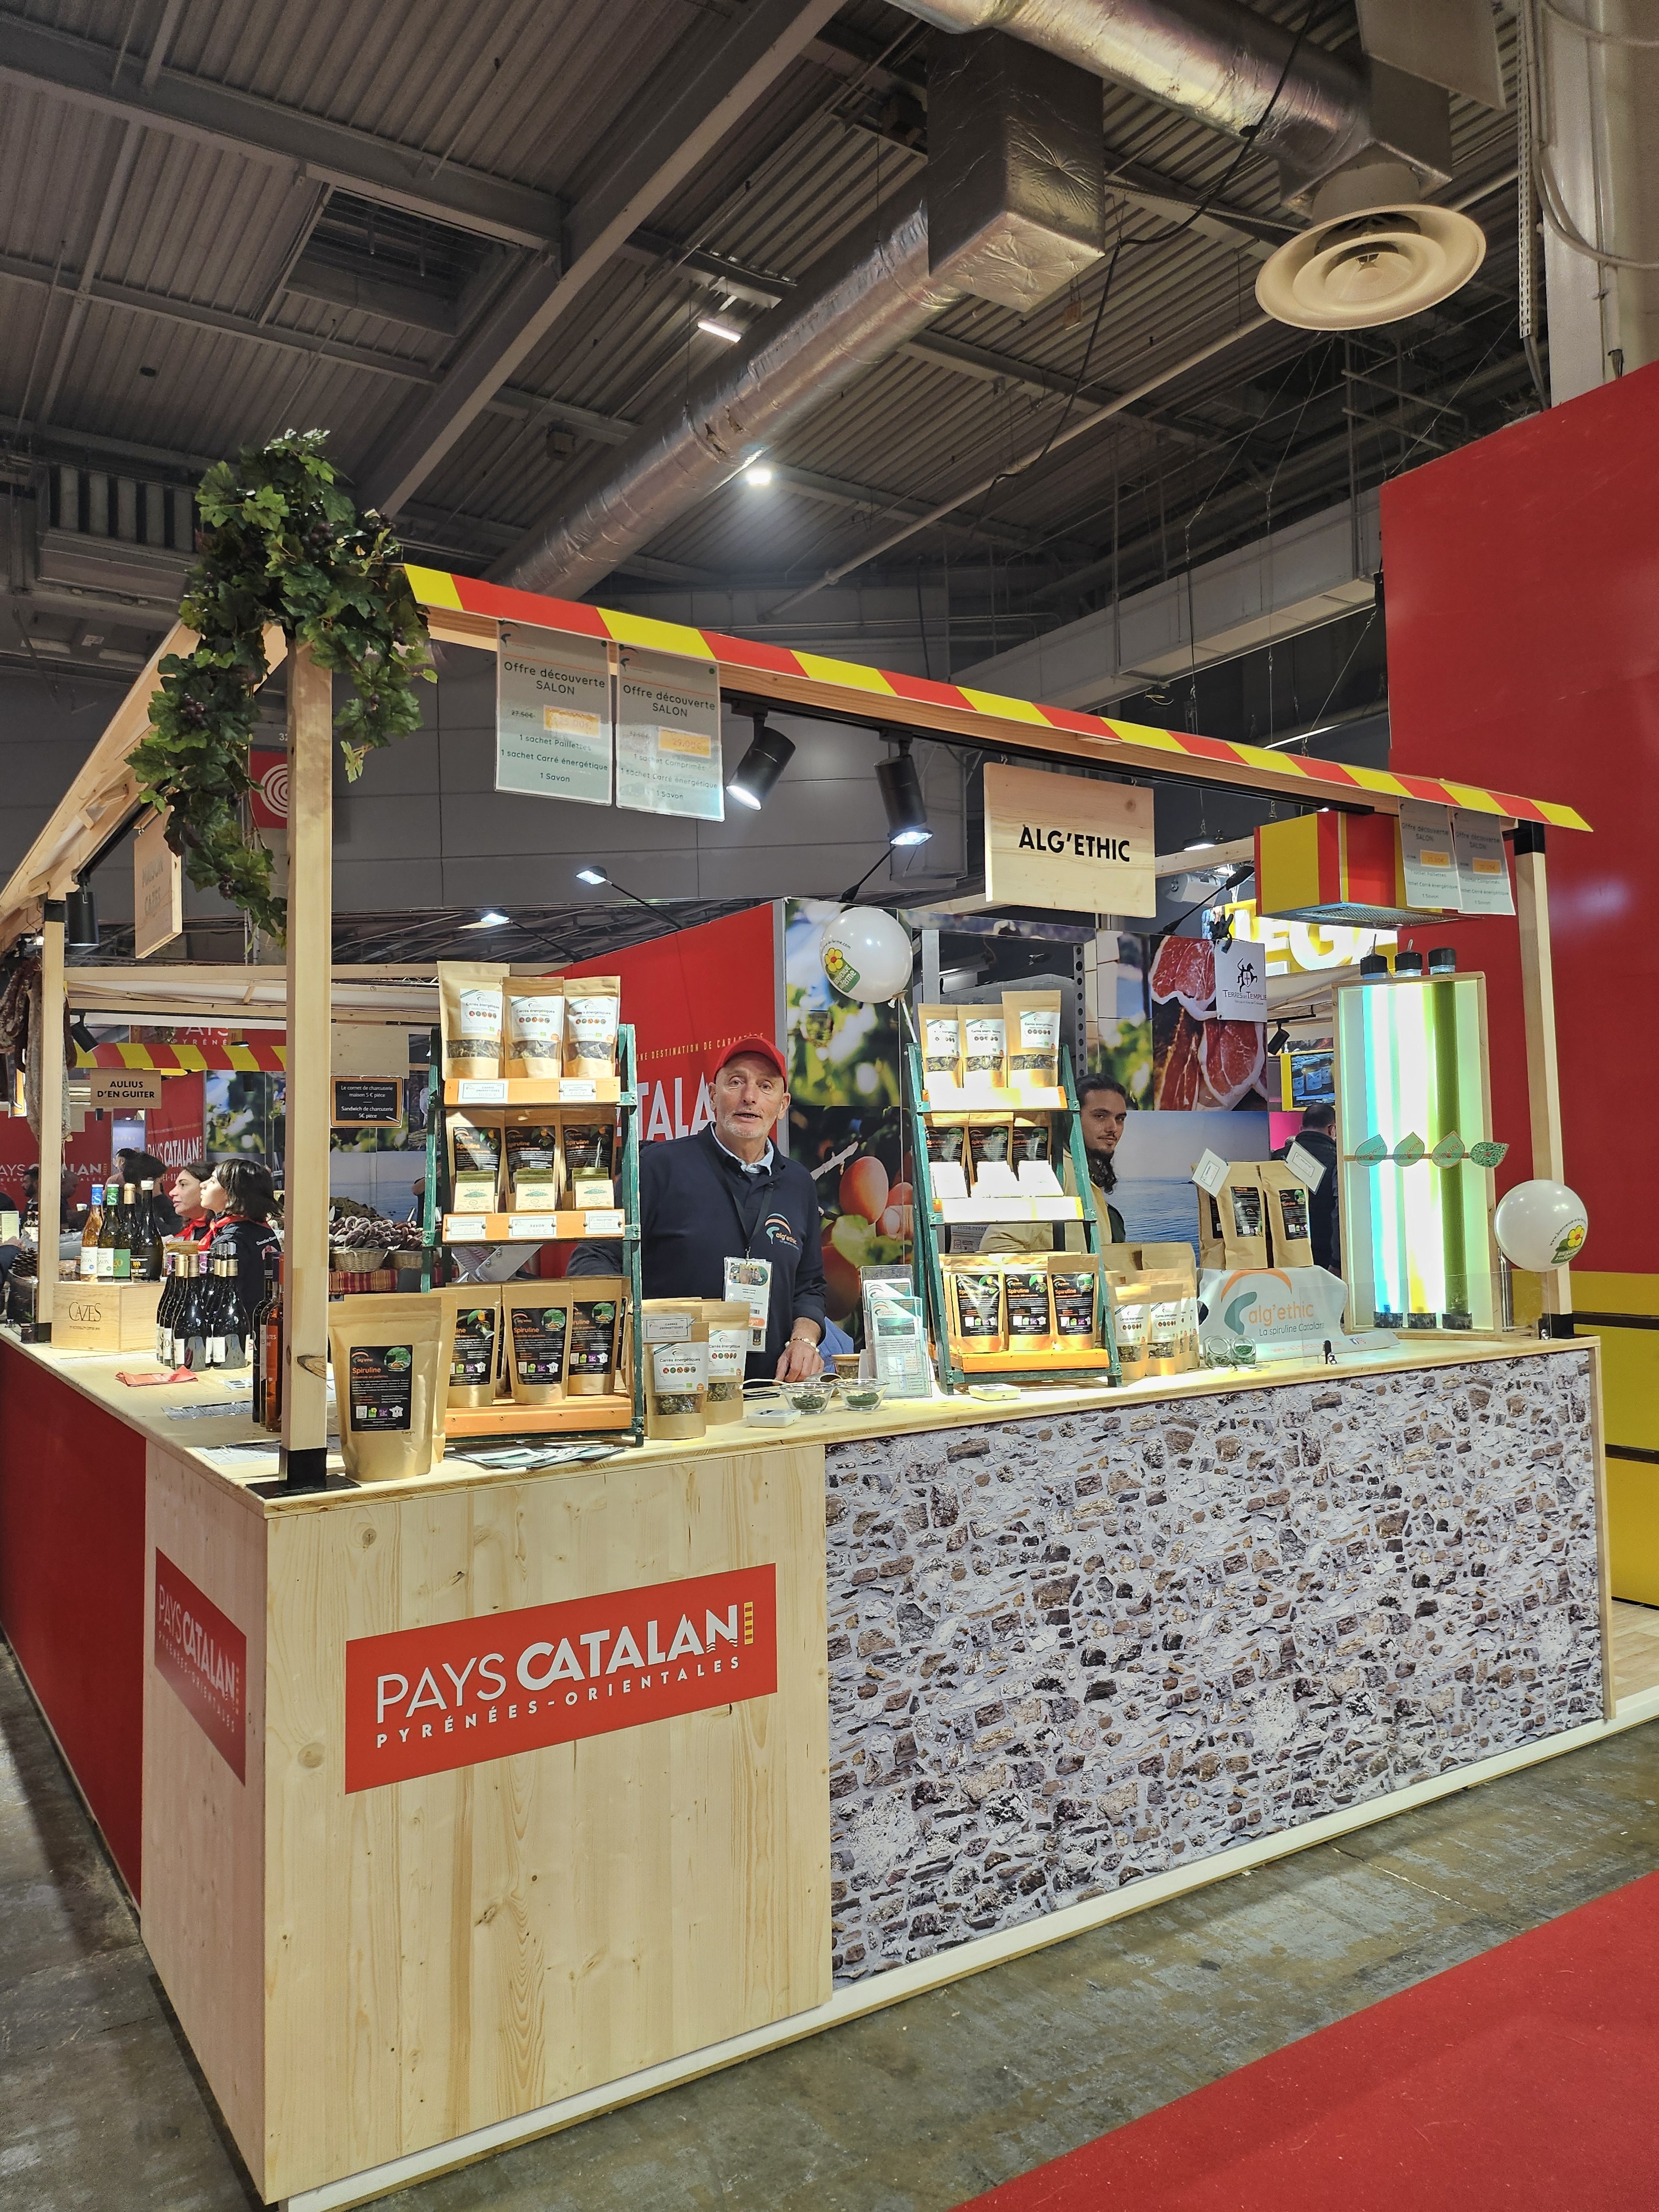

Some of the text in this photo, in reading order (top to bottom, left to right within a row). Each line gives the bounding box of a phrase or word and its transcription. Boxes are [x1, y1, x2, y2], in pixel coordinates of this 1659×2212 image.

[504, 661, 606, 688] Offre découverte
[536, 680, 575, 696] SALON
[623, 684, 716, 711] Offre découverte
[652, 702, 688, 718] SALON
[525, 735, 552, 745] sachet
[555, 739, 592, 752] Paillettes
[507, 750, 534, 760] sachet
[536, 754, 559, 763] Carré
[561, 758, 608, 771] énergétique
[639, 755, 662, 764] sachet
[665, 759, 706, 771] Comprimés
[546, 773, 570, 782] Savon
[626, 769, 650, 779] sachet
[653, 774, 672, 782] Carré
[675, 776, 718, 789] énergétique
[661, 791, 684, 800] Savon
[1401, 822, 1416, 831] Offre
[1019, 826, 1130, 863] ALG'ETHIC
[1469, 841, 1486, 849] SALON
[1222, 989, 1243, 999] TERRES
[651, 1044, 699, 1060] DESTINATION
[703, 1041, 712, 1050] DE
[97, 1090, 155, 1099] D'EN GUITER
[164, 1136, 200, 1168] CATALAN
[69, 1301, 102, 1322] CAZES
[1249, 1301, 1314, 1327] alg'ethic
[1259, 1328, 1267, 1337] La
[1269, 1324, 1297, 1337] spiruline
[352, 1366, 382, 1375] Spiruline
[158, 1584, 236, 1701] PAYS CATALAN
[376, 1604, 739, 1724] PAYS CATALAN
[376, 1656, 740, 1749] PYRÉNÉES-ORIENTALES
